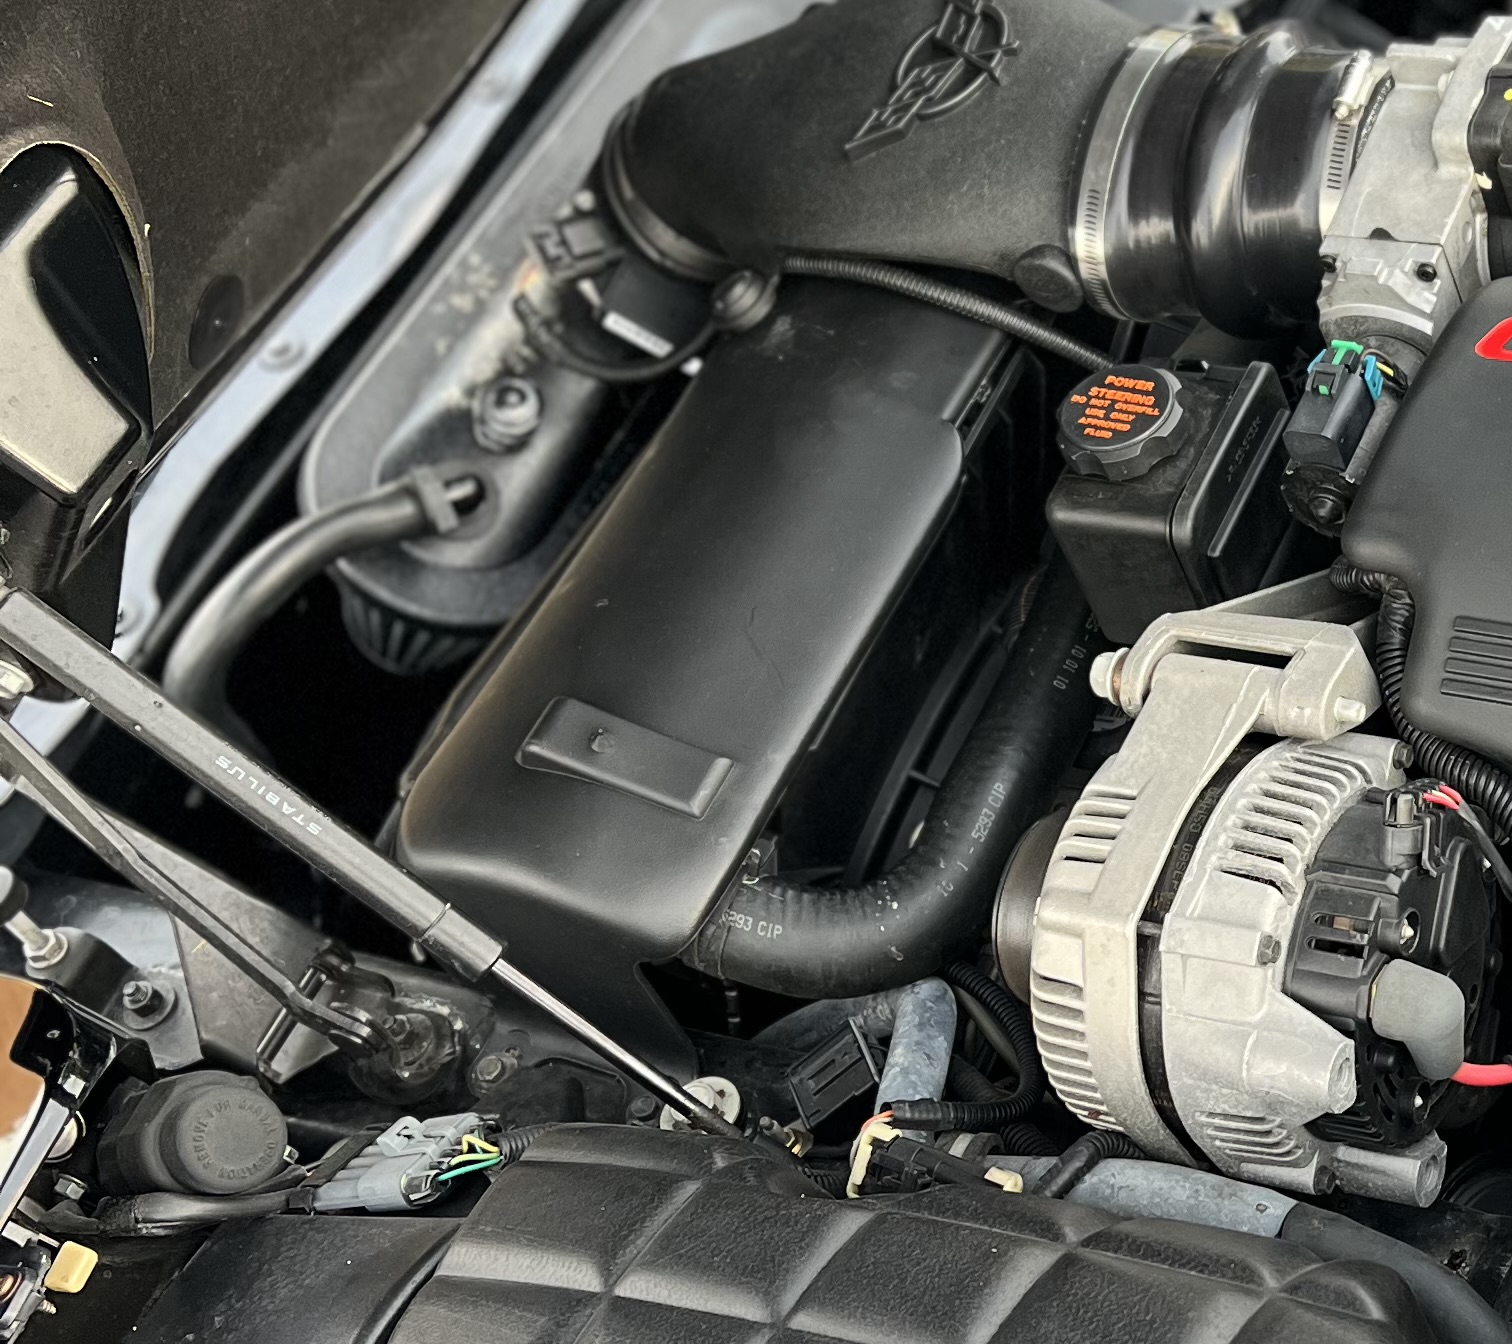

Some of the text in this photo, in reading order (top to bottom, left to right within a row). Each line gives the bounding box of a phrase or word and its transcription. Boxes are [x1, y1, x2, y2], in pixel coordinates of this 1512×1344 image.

[1104, 375, 1155, 391] POWER
[1070, 394, 1160, 416] DO NOT OVERFILL
[1088, 386, 1156, 406] STEERING
[1084, 407, 1136, 422] USE ONLY
[1077, 417, 1131, 432] APPROVED
[1083, 427, 1113, 439] FLUID
[215, 756, 324, 836] STABILUS
[971, 807, 996, 843] 5293
[988, 782, 1007, 808] CIP
[757, 921, 783, 939] CIP
